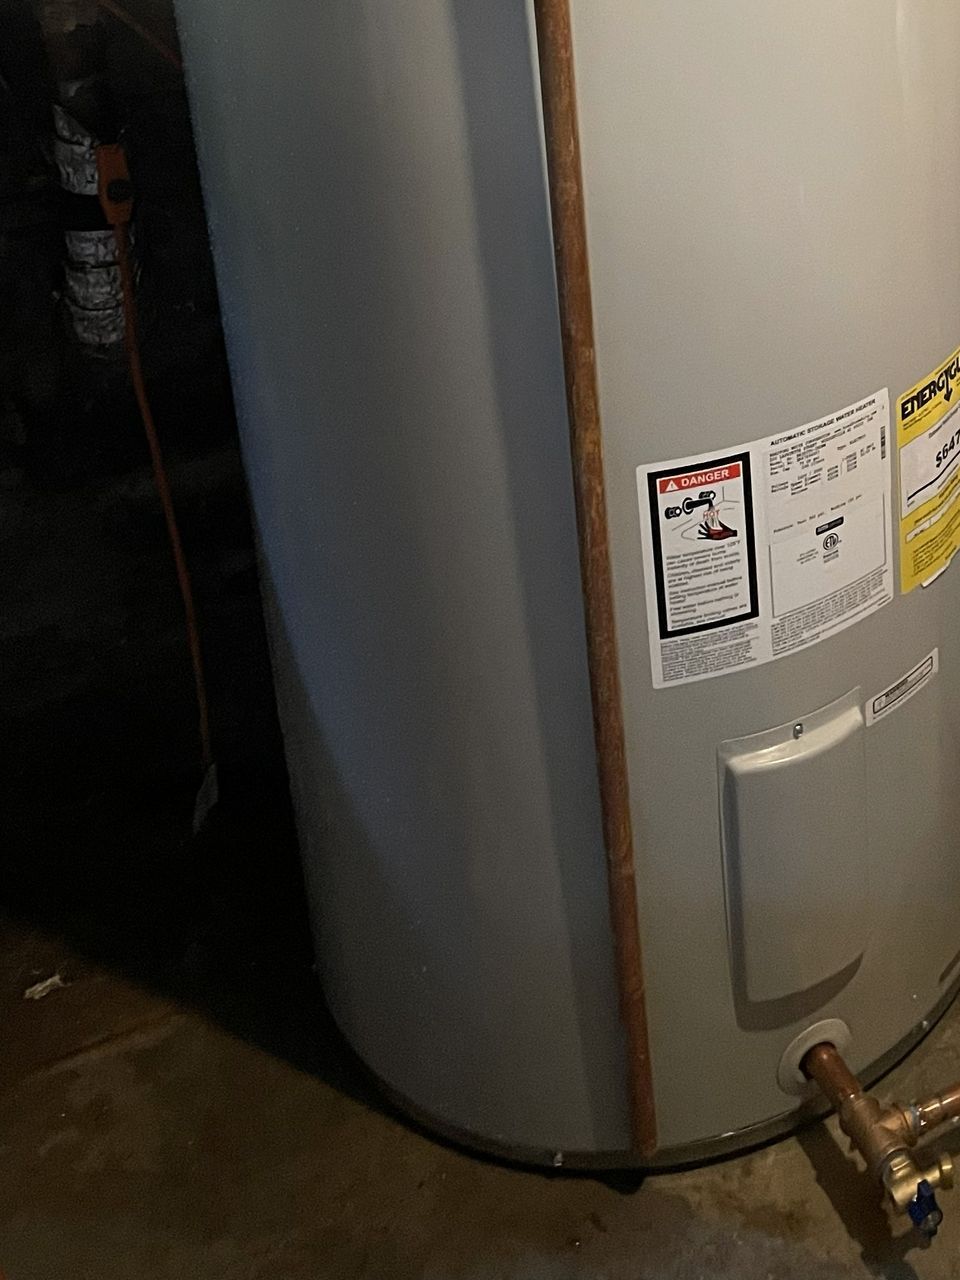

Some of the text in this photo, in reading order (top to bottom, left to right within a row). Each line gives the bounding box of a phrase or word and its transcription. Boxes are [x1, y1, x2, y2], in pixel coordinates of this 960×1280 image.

[770, 398, 876, 446] AUTOMATIC STORAGE WATER HEATER
[681, 469, 730, 487] DANGER
[702, 509, 721, 520] HOT
